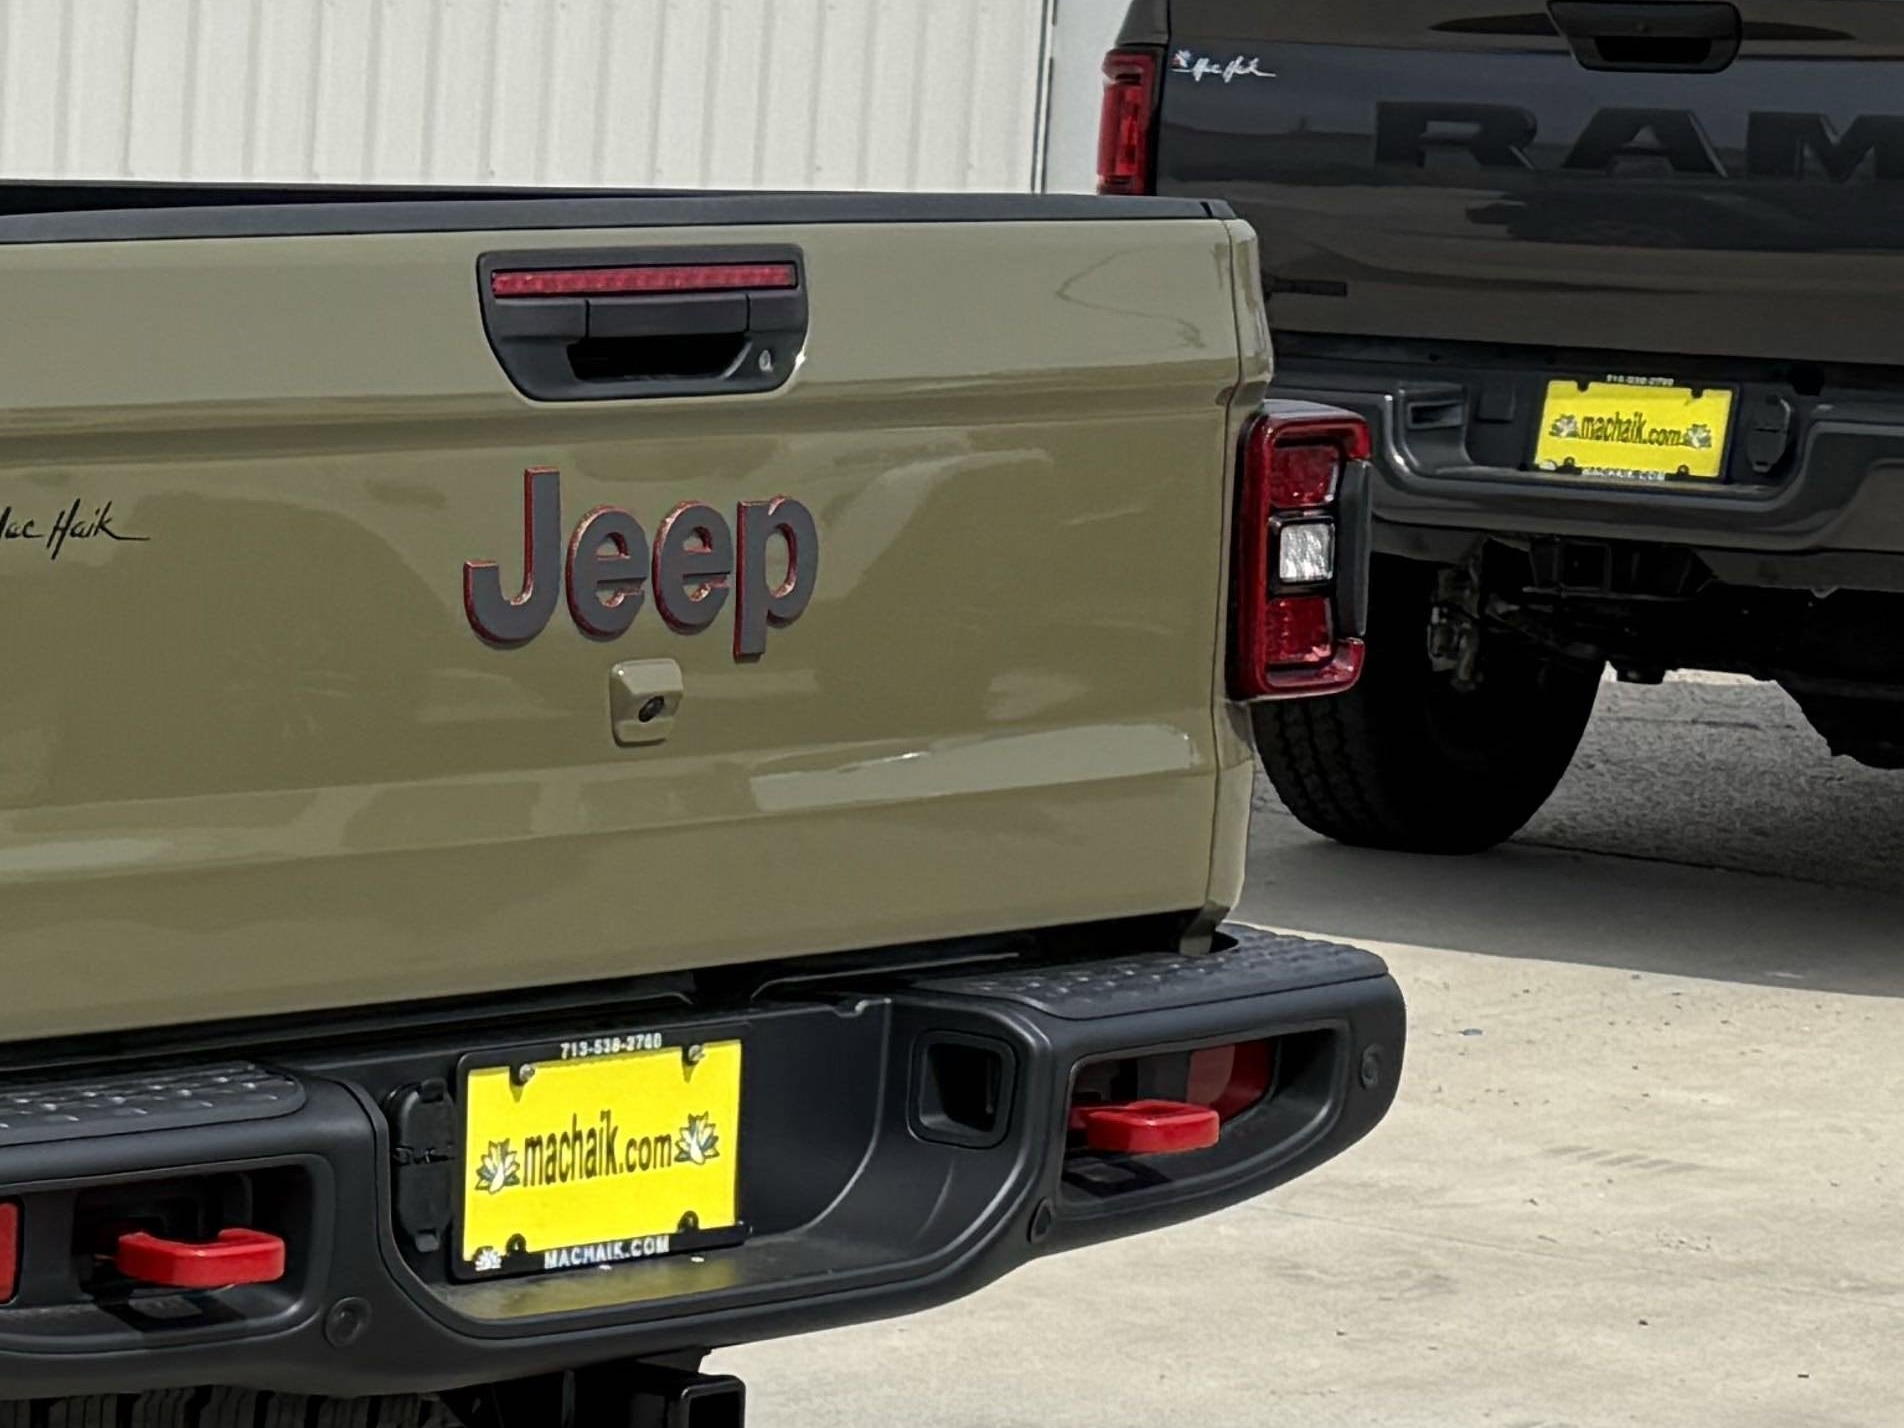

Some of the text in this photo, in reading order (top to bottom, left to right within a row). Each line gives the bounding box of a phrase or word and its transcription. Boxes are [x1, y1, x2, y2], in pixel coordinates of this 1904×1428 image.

[1374, 101, 1904, 180] RAM
[1580, 410, 1684, 447] machaik.com
[45, 497, 142, 561] Haik
[462, 466, 819, 662] Jeep
[521, 1109, 673, 1188] machaik.com
[543, 1235, 671, 1270] MACHAIK.COM
